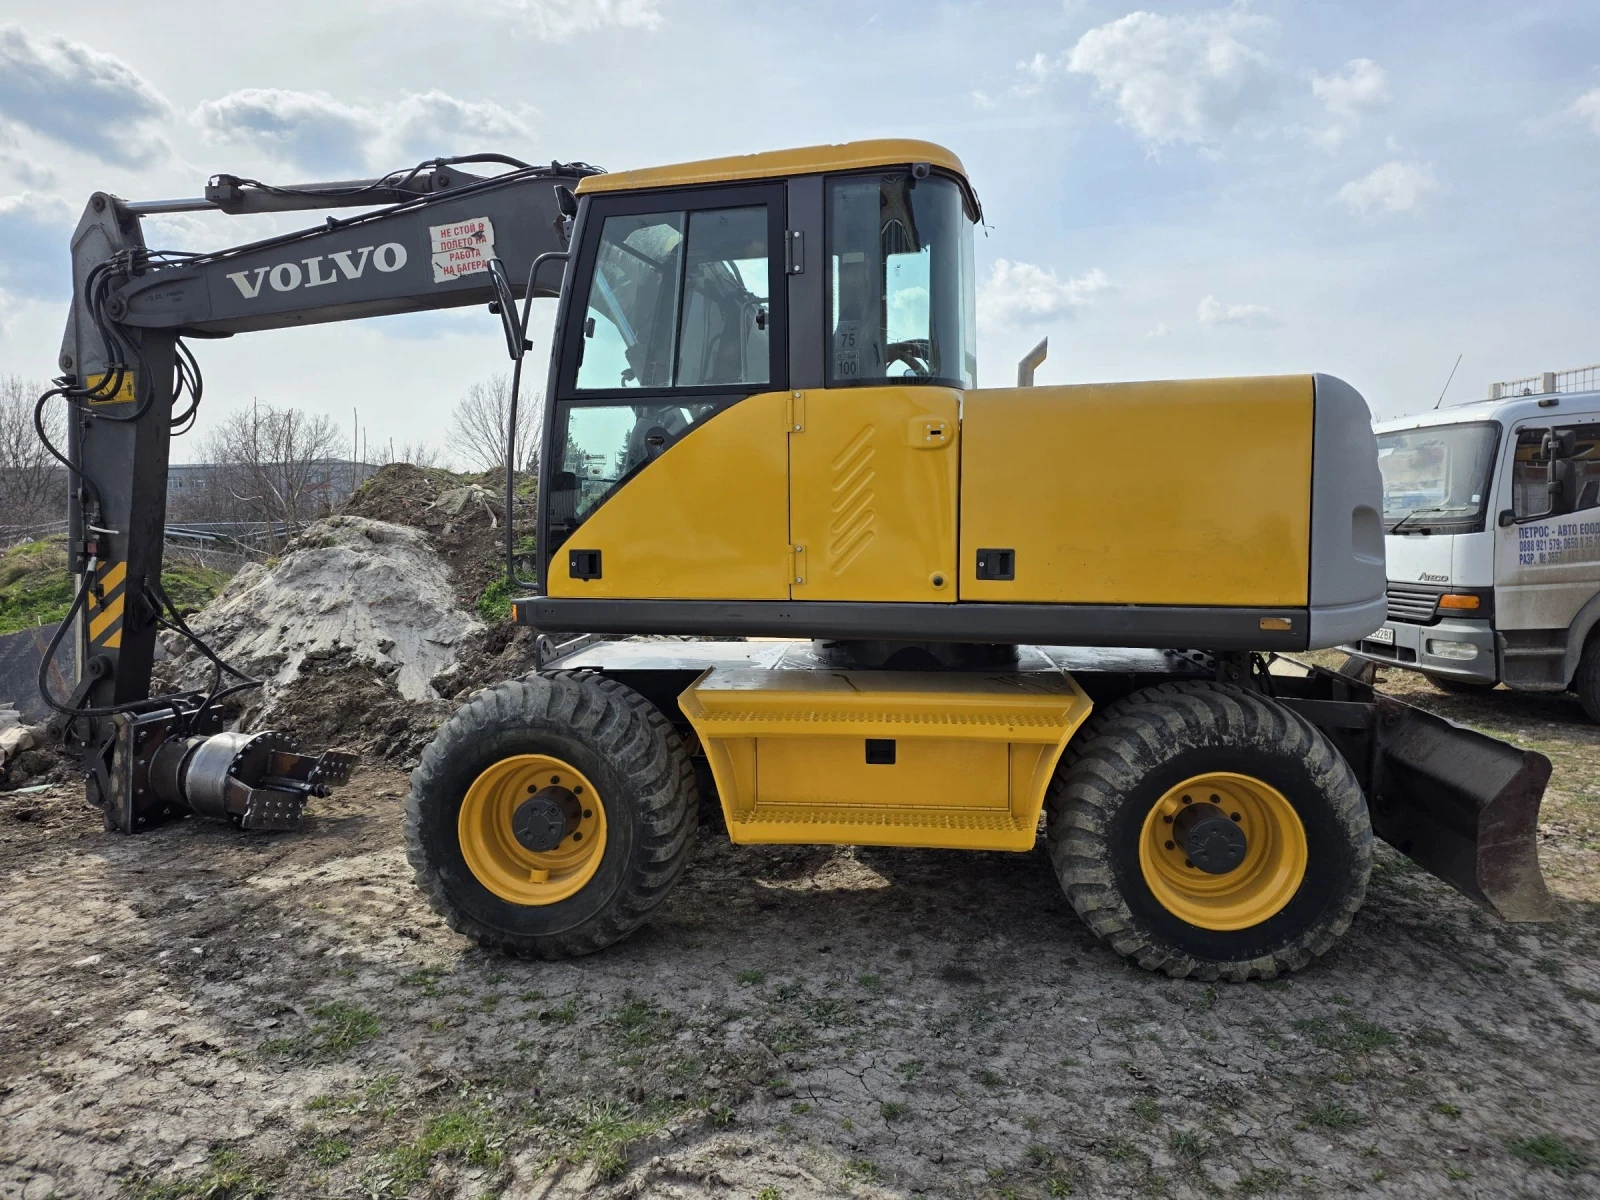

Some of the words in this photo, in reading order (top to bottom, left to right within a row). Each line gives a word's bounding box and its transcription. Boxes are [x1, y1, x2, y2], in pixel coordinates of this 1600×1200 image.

[440, 229, 451, 238] НЕ
[454, 223, 475, 236] СТОЙ
[440, 237, 473, 251] ПОЛЕТО
[475, 234, 487, 245] НА
[449, 248, 481, 262] РАБОТА
[226, 242, 407, 299] VOLVO
[443, 265, 455, 275] НА
[457, 259, 488, 273] БАГЕРА
[841, 333, 855, 347] 75
[839, 361, 857, 375] 100
[1518, 525, 1549, 539] ПЕТРОС
[1558, 524, 1577, 536] АВТО
[1519, 540, 1535, 552] 0888
[1536, 539, 1547, 551] 921
[1519, 553, 1536, 565] РАЗР.
